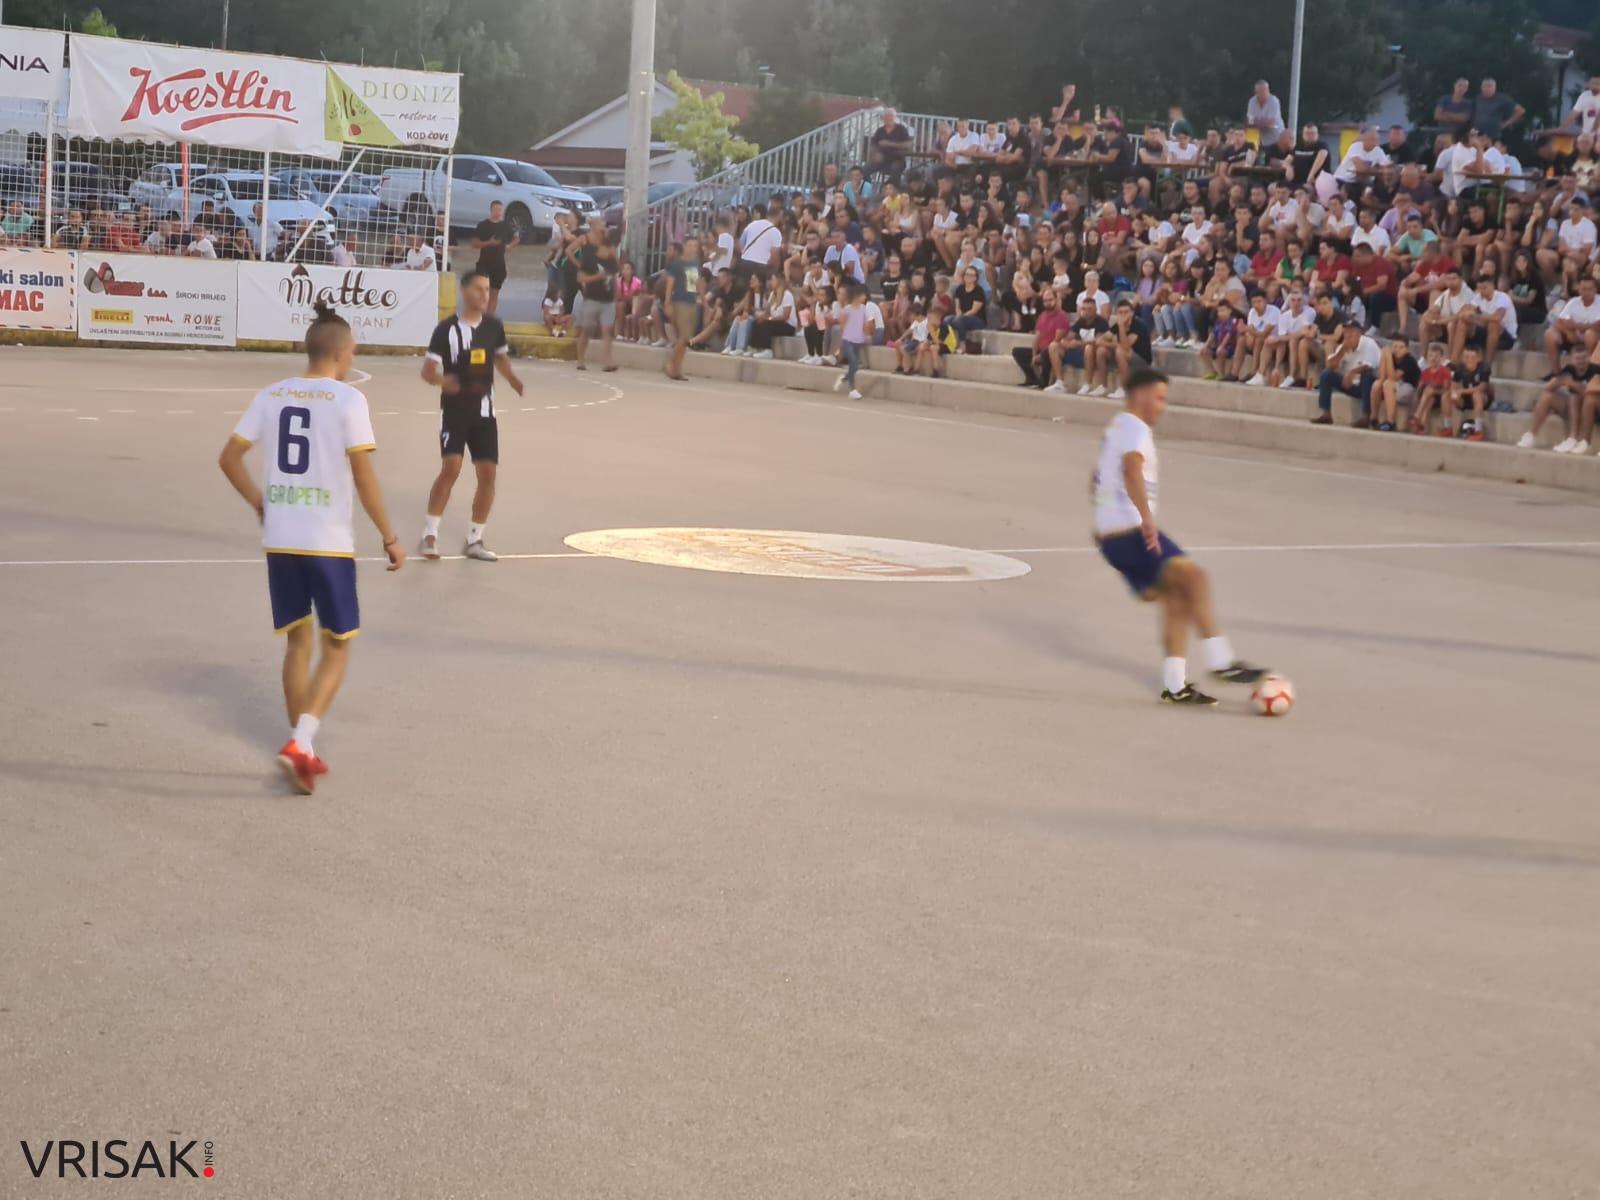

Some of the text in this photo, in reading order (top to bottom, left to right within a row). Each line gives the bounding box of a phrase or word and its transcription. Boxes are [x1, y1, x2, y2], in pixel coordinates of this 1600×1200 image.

[120, 66, 298, 122] Koestlin
[361, 77, 457, 103] DIONIZ
[406, 131, 426, 141] KOD
[19, 271, 64, 288] salon
[279, 270, 399, 311] Matteo
[0, 289, 44, 312] MAC
[183, 313, 222, 326] ROWE
[290, 313, 392, 330] RERANT
[277, 405, 311, 475] 6
